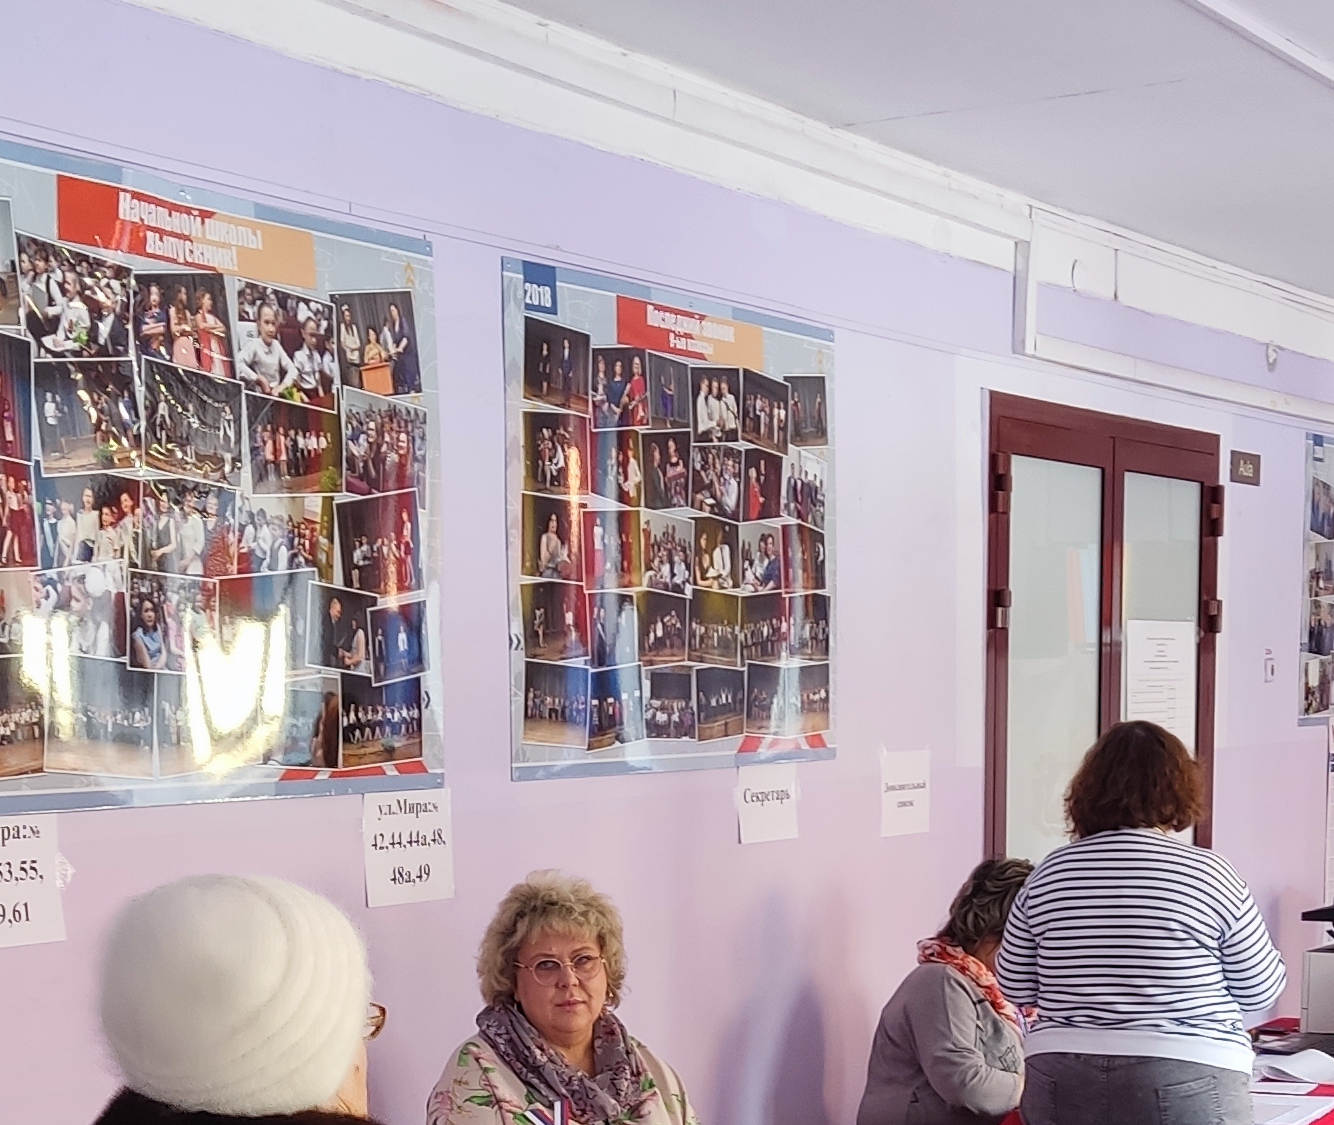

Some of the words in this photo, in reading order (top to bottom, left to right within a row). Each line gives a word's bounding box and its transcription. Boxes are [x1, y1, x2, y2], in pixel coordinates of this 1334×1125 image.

[119, 191, 203, 237] Начальной
[205, 217, 263, 250] школы
[524, 282, 552, 308] 2018
[743, 787, 791, 807] Секретарь
[390, 863, 431, 886] 48а,49
